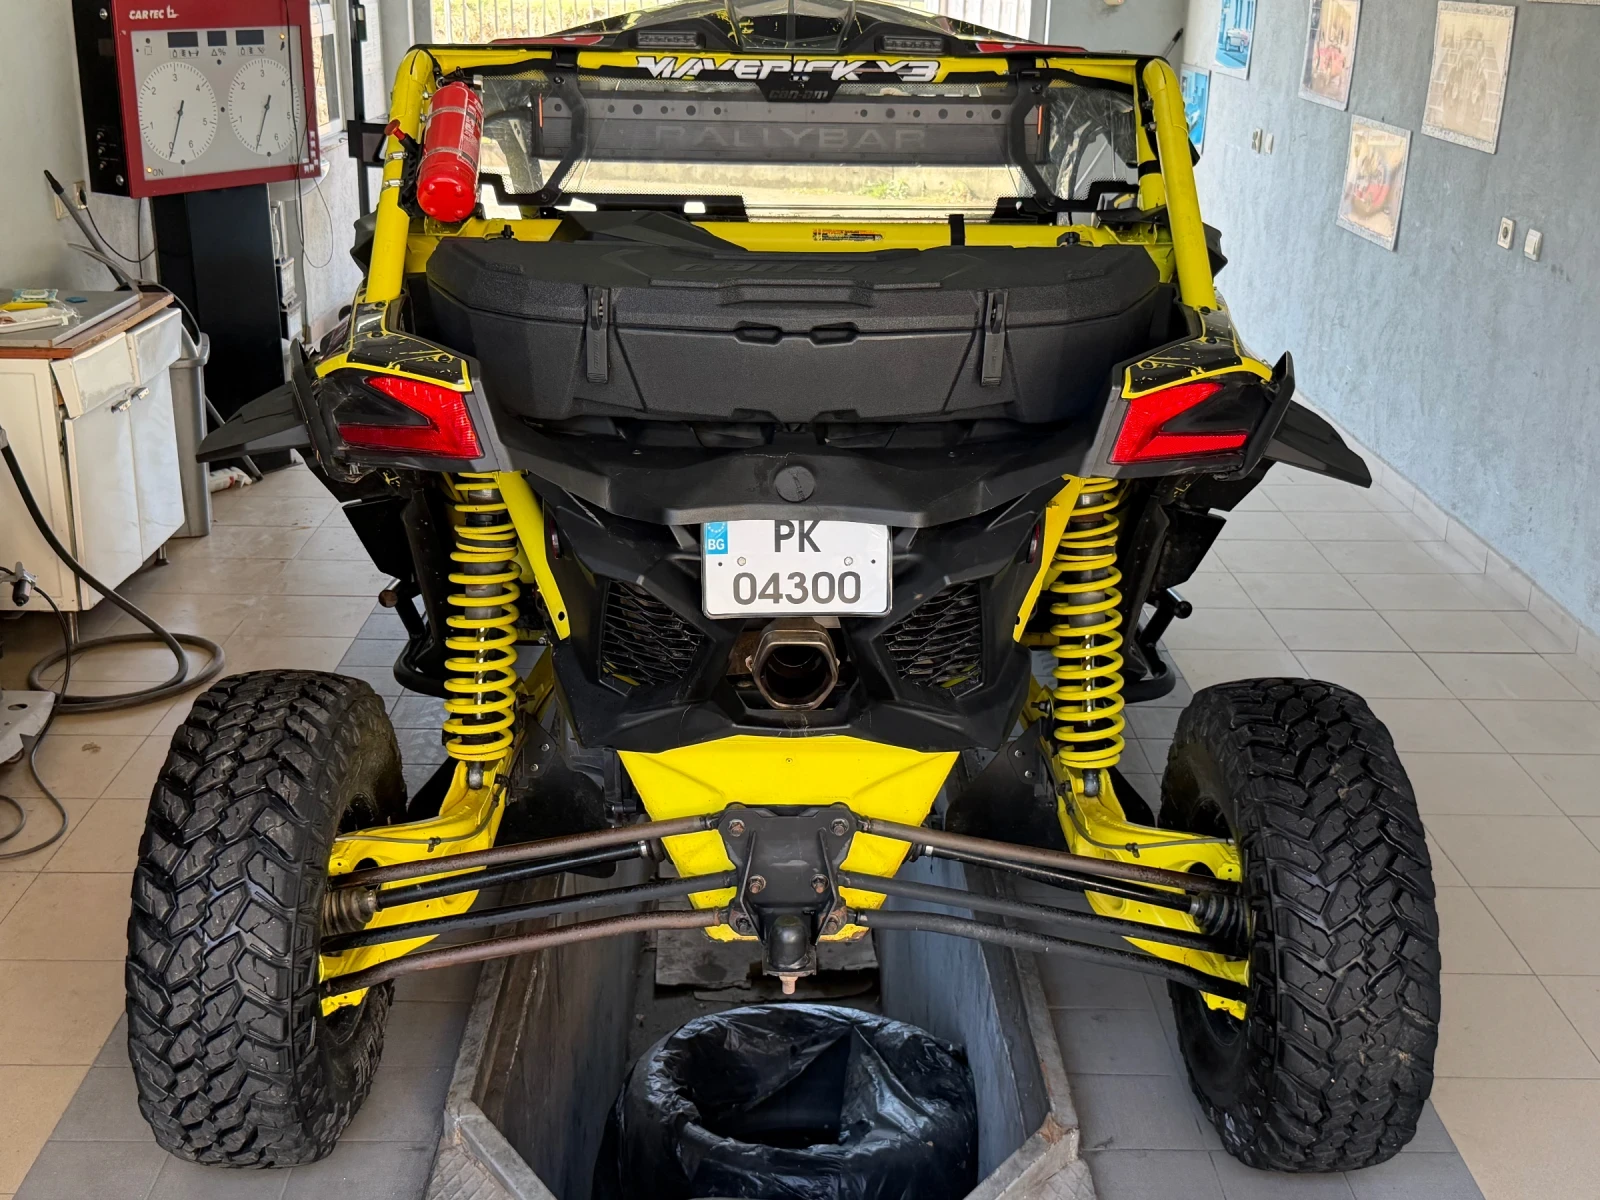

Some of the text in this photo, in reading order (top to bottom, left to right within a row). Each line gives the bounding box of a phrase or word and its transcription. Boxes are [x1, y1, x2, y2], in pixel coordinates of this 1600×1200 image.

[128, 9, 165, 20] CARTEC
[637, 56, 866, 81] MAVERICK
[768, 89, 829, 100] can-am
[655, 125, 928, 150] RALLYBAR
[152, 168, 164, 177] ON
[707, 538, 726, 551] BG
[774, 520, 822, 553] PK
[732, 571, 862, 605] 04300
